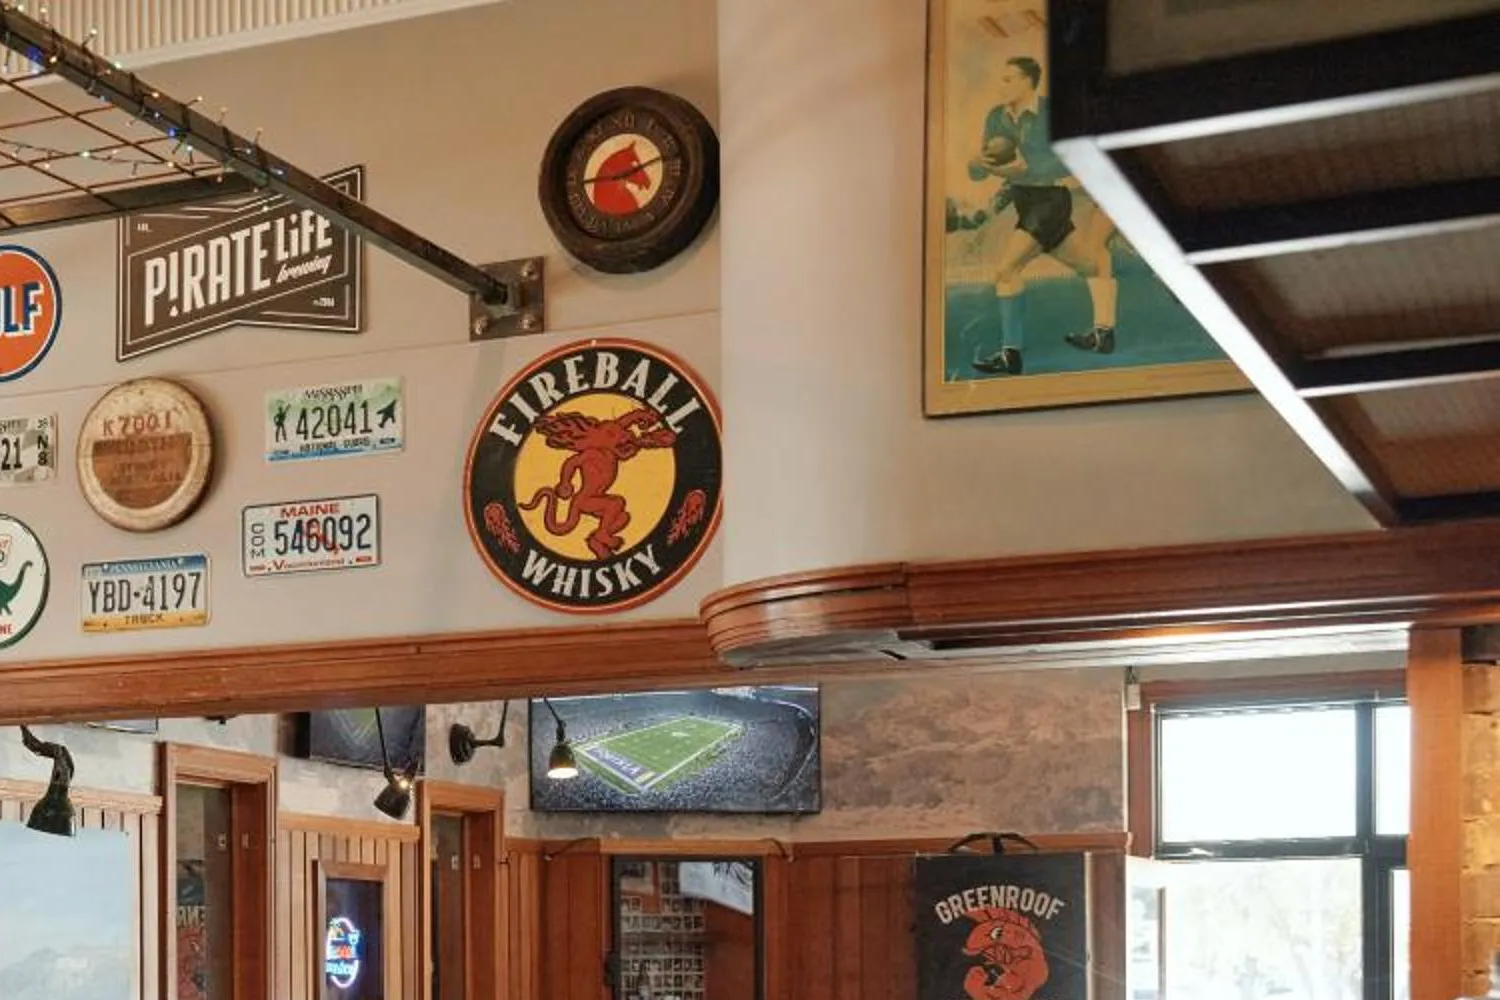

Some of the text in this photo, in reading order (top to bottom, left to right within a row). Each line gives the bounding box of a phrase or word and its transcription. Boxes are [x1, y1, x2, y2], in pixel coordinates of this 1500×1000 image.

[296, 400, 373, 441] 42041
[490, 352, 700, 447] FIREBALL
[281, 503, 340, 518] MAINE
[274, 513, 372, 556] 546092
[521, 544, 662, 599] WHISKY
[934, 885, 1066, 925] GREENROOF
